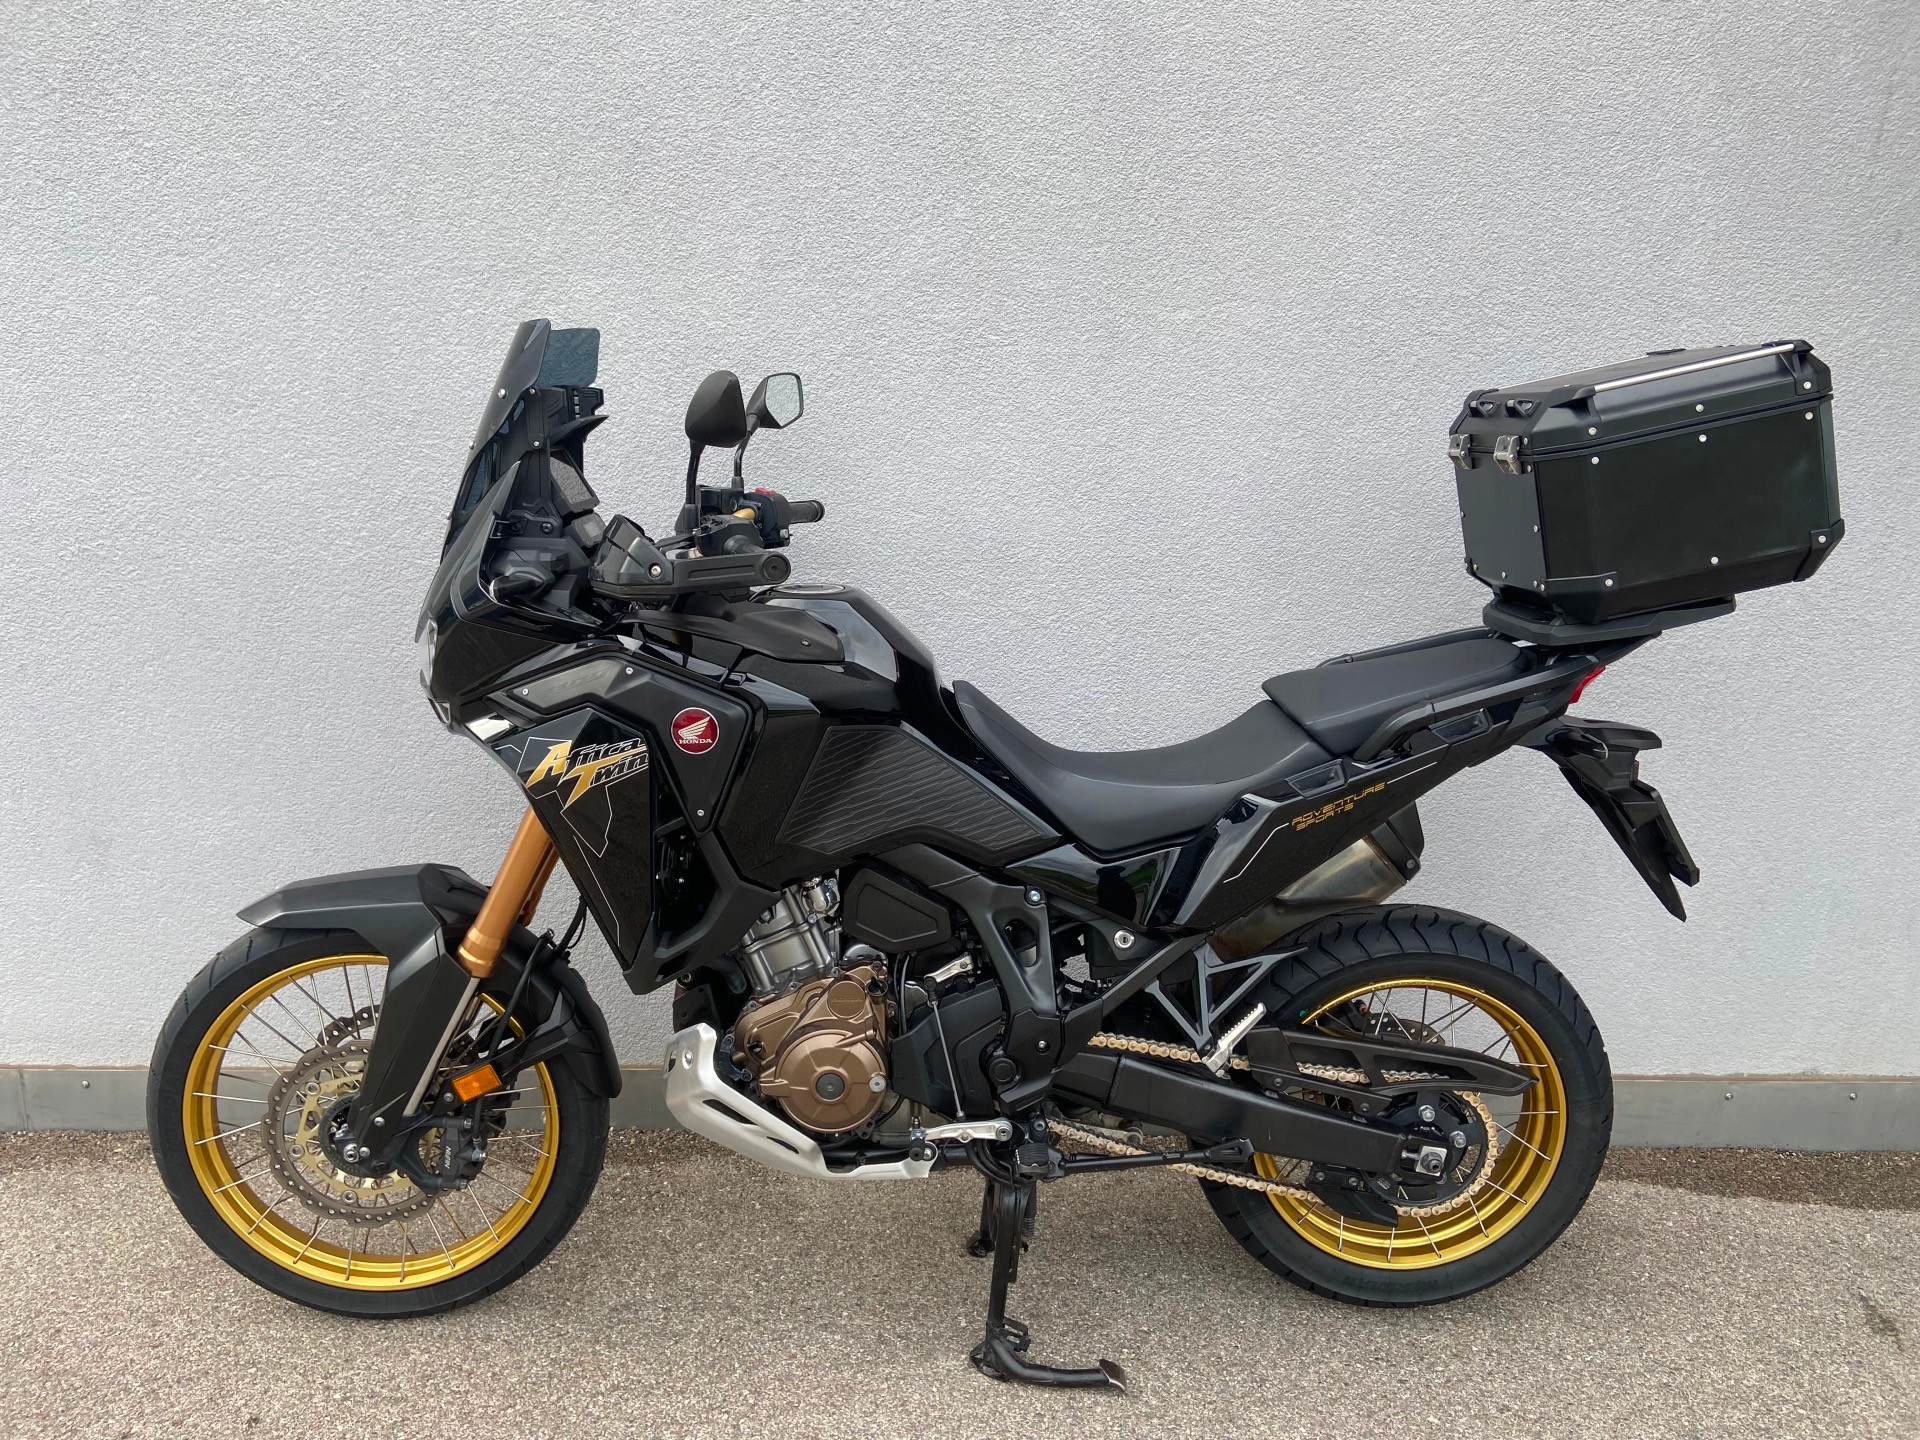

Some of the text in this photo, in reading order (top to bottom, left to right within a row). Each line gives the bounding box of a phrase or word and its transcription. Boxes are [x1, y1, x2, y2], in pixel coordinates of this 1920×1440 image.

[525, 738, 642, 788] Africa
[560, 745, 649, 809] Twin
[1292, 782, 1386, 826] ADVENTURE
[1296, 802, 1354, 831] SPORTS
